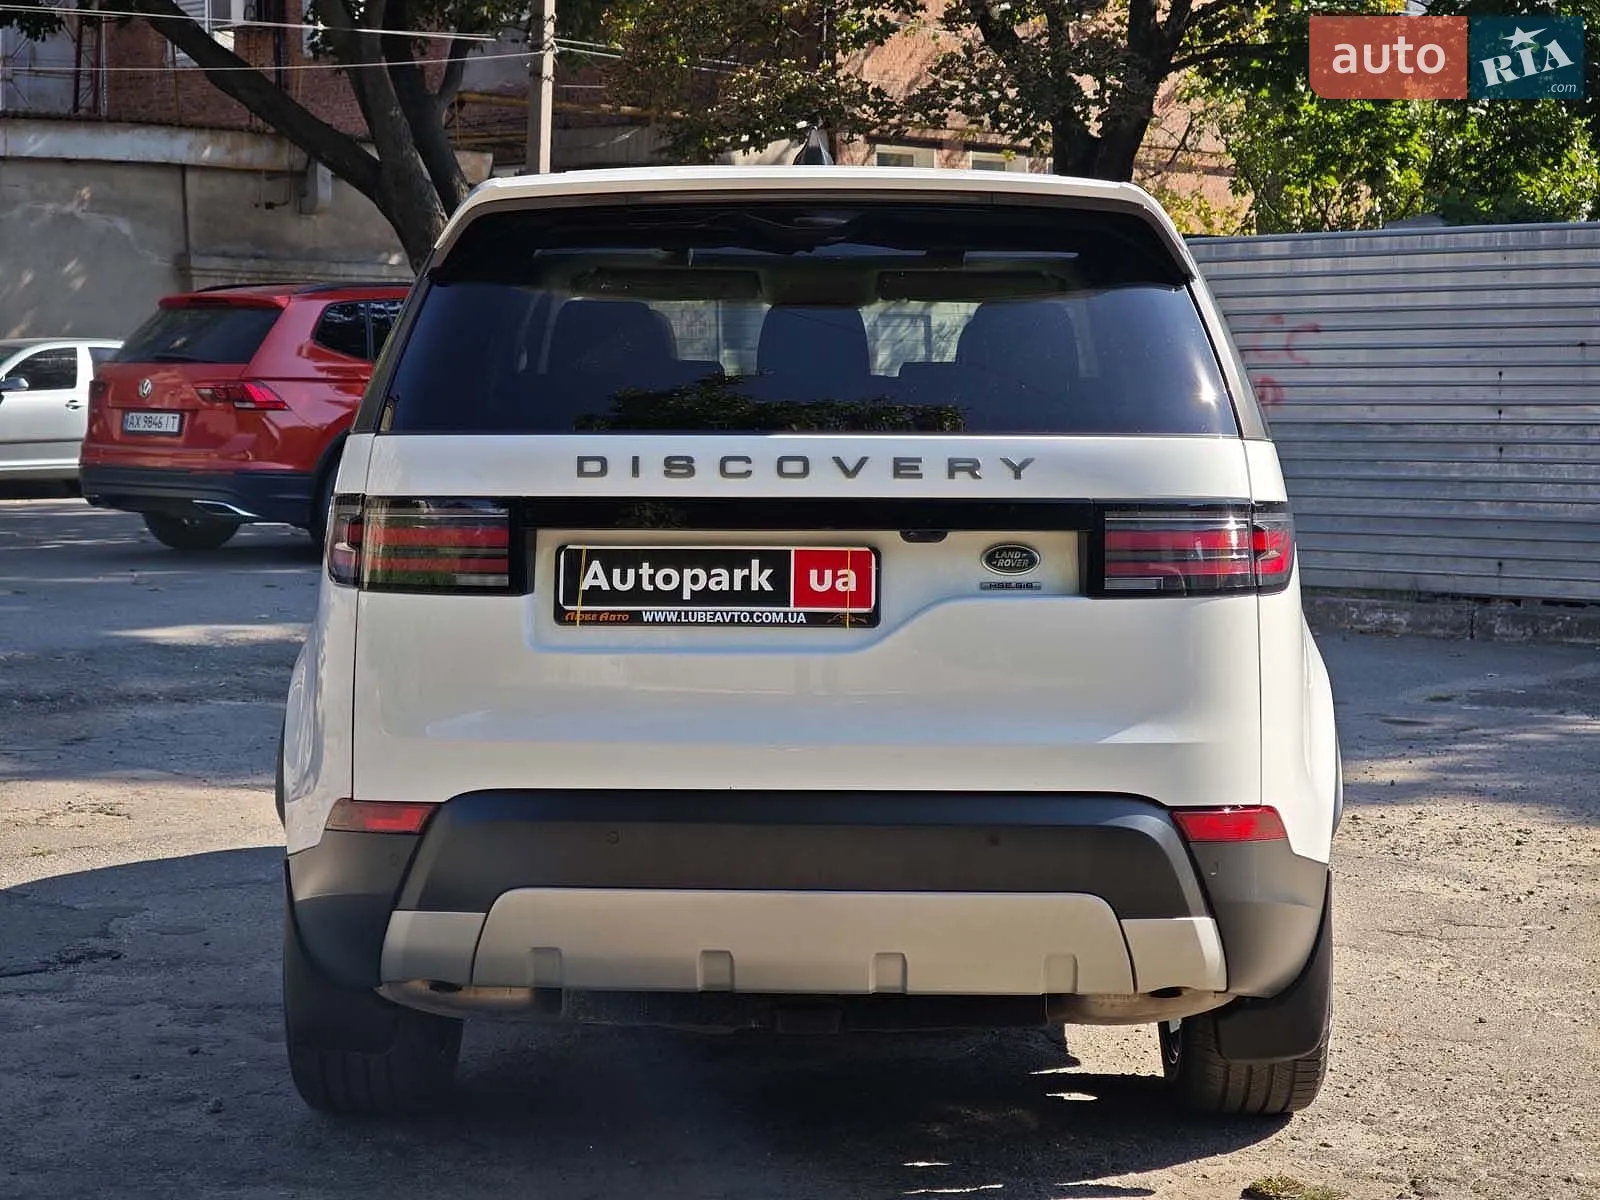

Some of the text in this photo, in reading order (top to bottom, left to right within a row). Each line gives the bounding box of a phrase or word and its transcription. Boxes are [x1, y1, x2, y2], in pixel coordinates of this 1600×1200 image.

[576, 455, 1036, 480] DISCOVERY
[995, 551, 1021, 559] LAND
[997, 559, 1029, 567] ROVER
[580, 559, 858, 601] Autopark ua
[642, 610, 808, 624] WWW.LUBEAVTO.COM.UA
